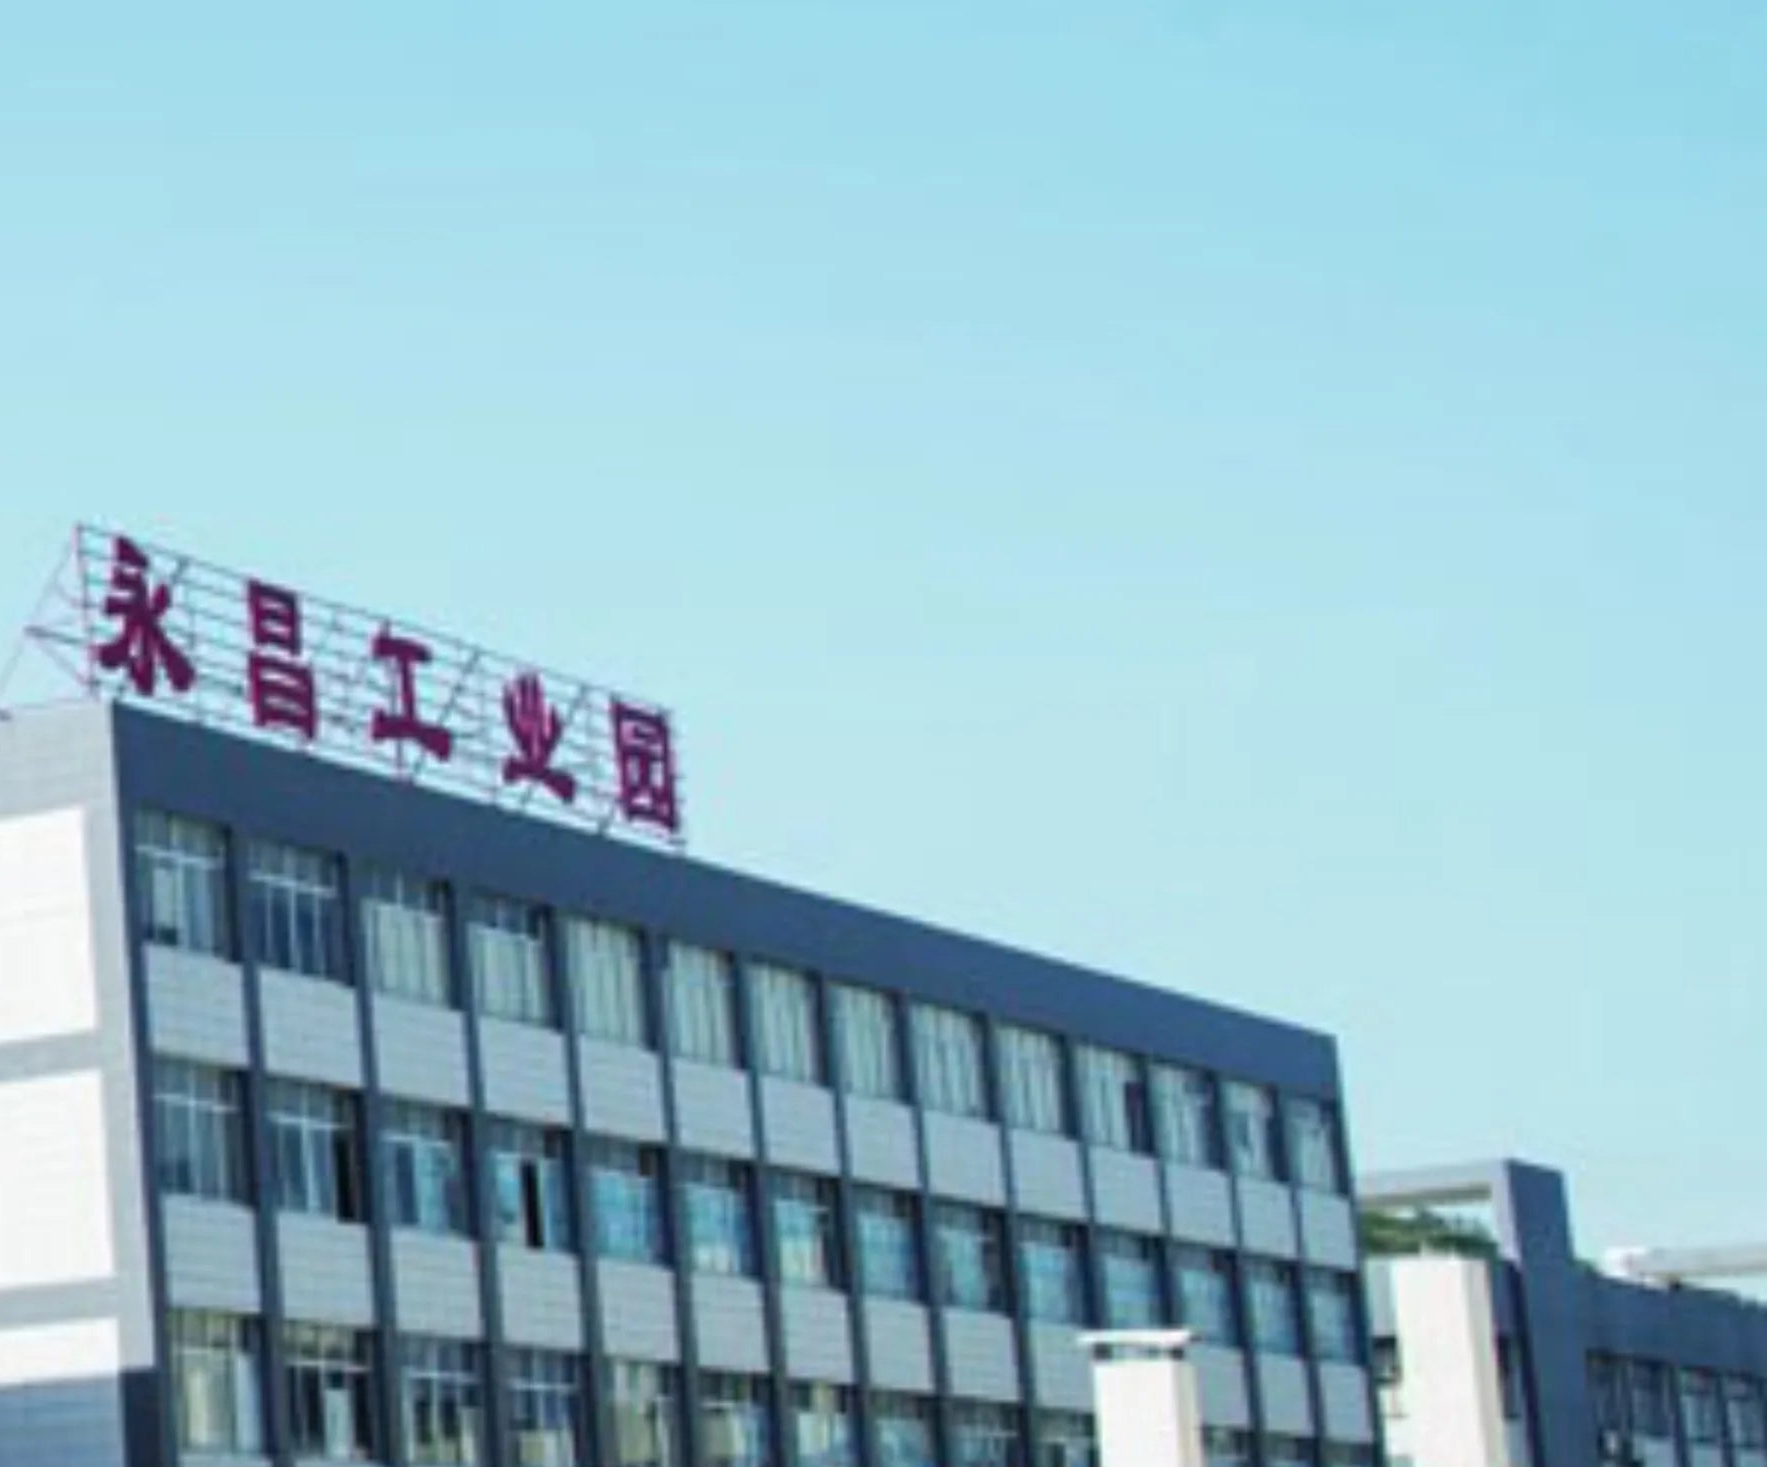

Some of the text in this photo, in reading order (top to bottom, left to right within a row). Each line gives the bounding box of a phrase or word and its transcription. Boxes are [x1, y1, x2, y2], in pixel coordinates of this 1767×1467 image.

[91, 534, 679, 832] 永昌工业园
